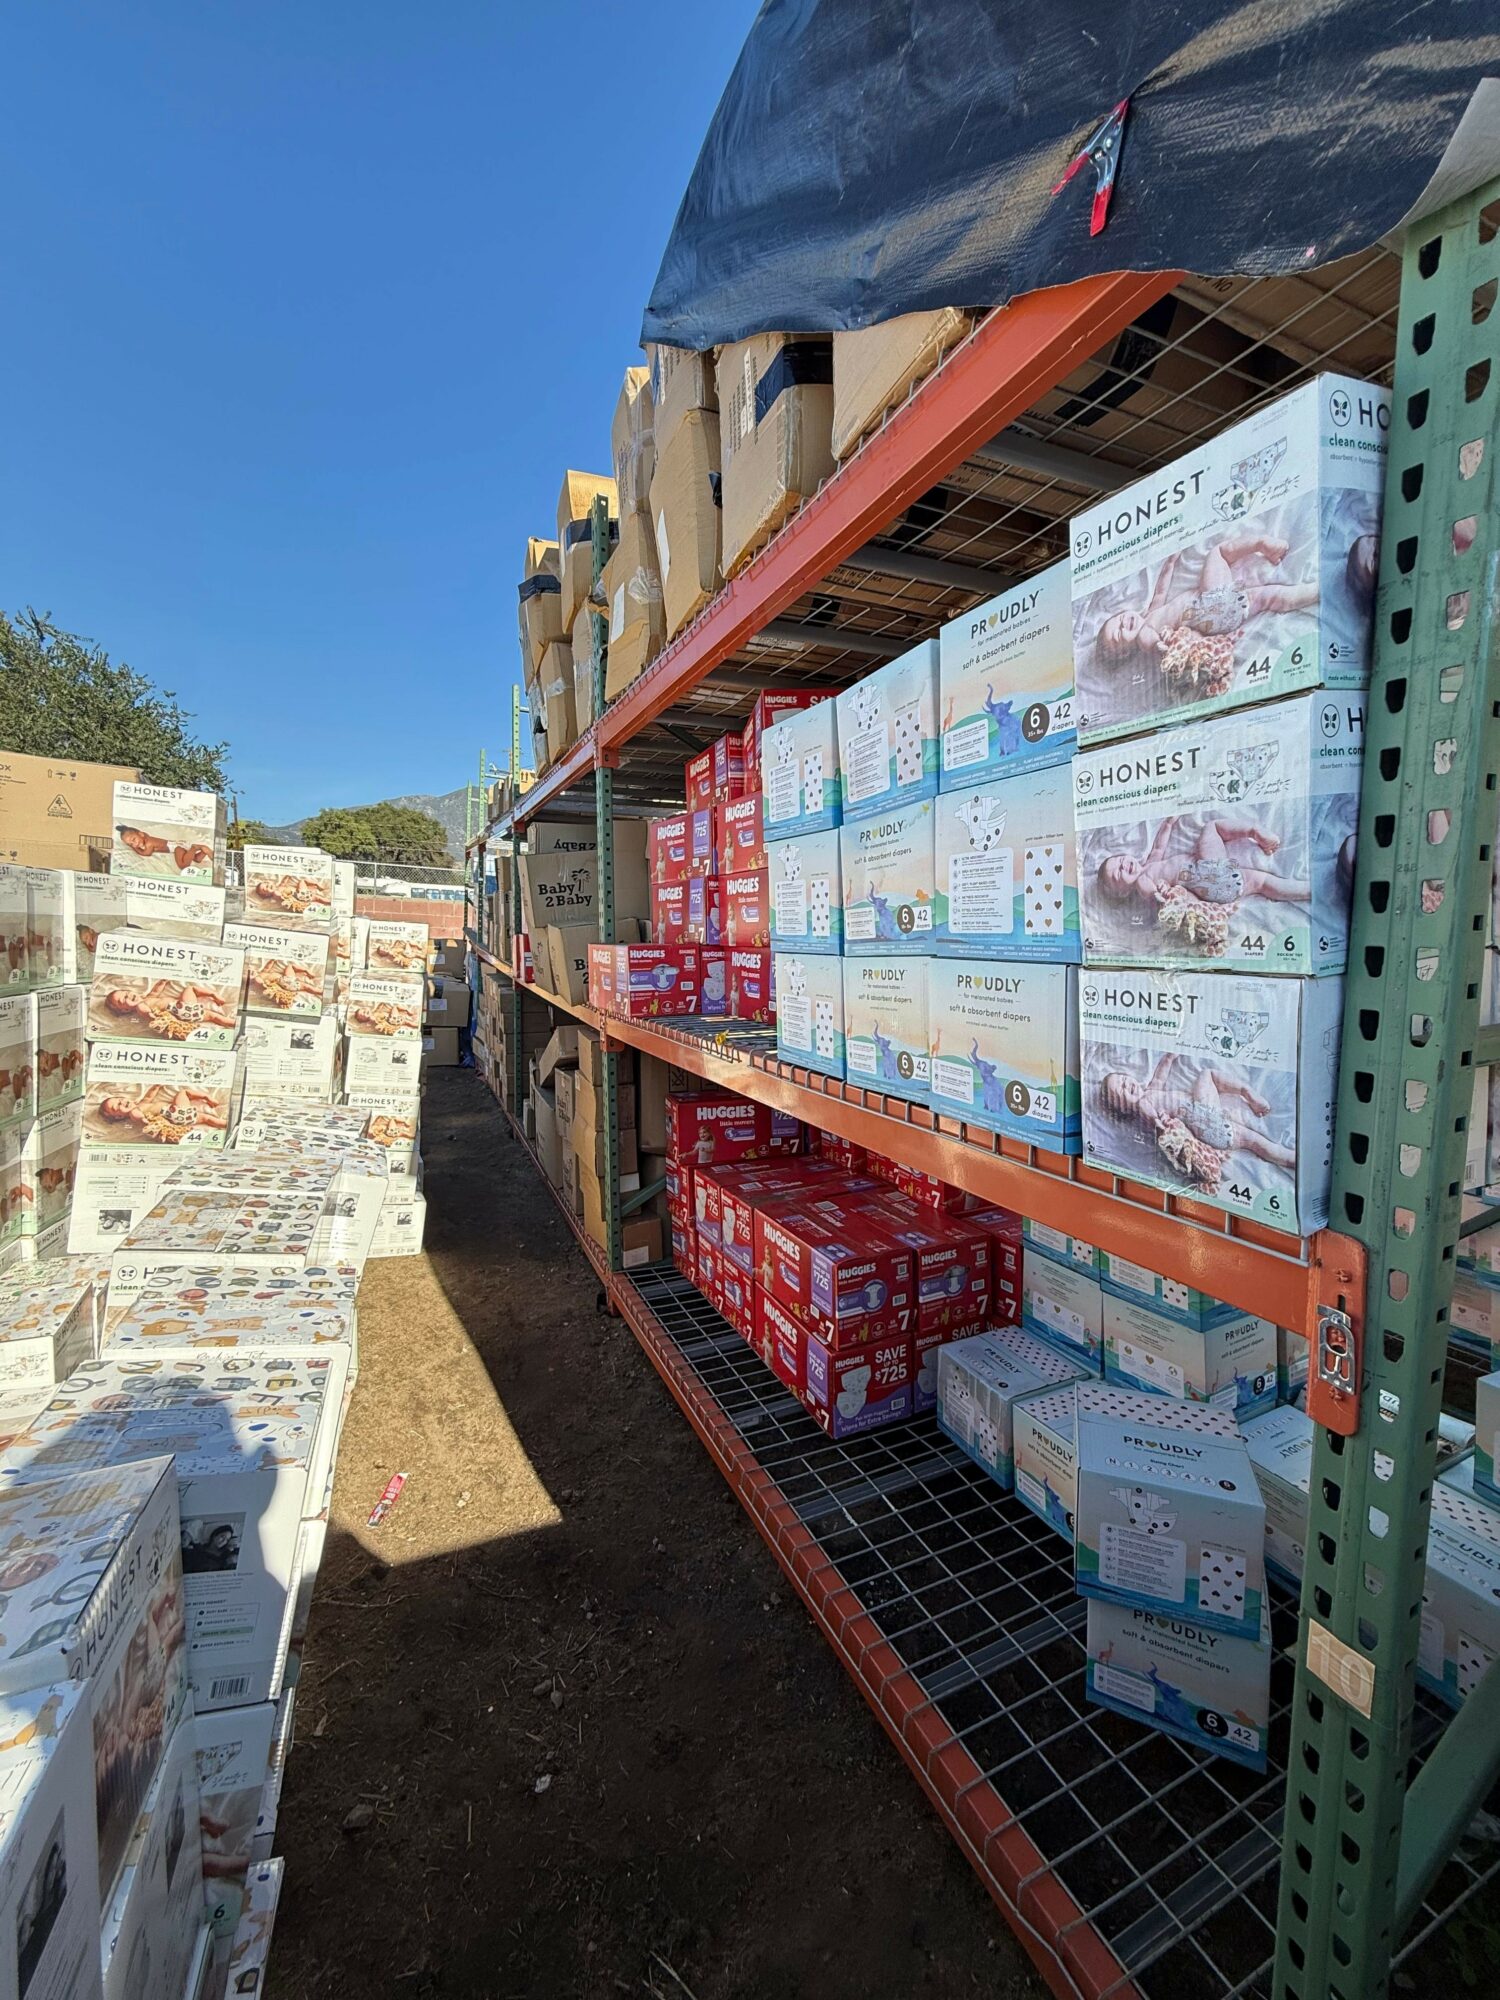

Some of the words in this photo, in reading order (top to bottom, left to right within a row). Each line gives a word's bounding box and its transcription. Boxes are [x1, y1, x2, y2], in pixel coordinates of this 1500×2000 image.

[1329, 432, 1355, 448] clean
[1098, 469, 1204, 546] HONEST
[1073, 559, 1095, 575] clean
[1097, 535, 1141, 563] conscious
[1143, 515, 1179, 540] diapers
[962, 657, 975, 671] soft
[975, 655, 981, 664] &
[982, 638, 1017, 661] absorbent
[1019, 624, 1050, 644] diapers
[1290, 647, 1303, 666] 6
[1246, 656, 1271, 678] 44
[764, 695, 797, 705] HUGGIES
[1030, 708, 1040, 728] 6
[1054, 702, 1071, 720] 42
[1051, 720, 1075, 732] diapers
[1320, 743, 1345, 757] clean
[1100, 747, 1200, 788] HONEST
[134, 786, 183, 800] HONEST
[723, 786, 729, 802] 7
[1076, 798, 1097, 808] clean
[1100, 789, 1141, 803] conscious
[1143, 782, 1177, 796] diapers
[725, 800, 756, 823] HUGGIES
[657, 822, 686, 840] HUGGIES
[262, 853, 305, 864] HONEST
[867, 852, 892, 863] absorbent
[892, 847, 912, 858] diapers
[703, 859, 710, 876] 7
[83, 876, 109, 885] HONEST
[138, 881, 190, 895] HONEST
[537, 883, 575, 895] Baby
[726, 877, 760, 896] HUGGIES
[658, 886, 683, 902] HUGGIES
[902, 908, 910, 923] 6
[917, 910, 928, 921] 42
[240, 933, 289, 946] HONEST
[698, 927, 705, 944] 7
[1240, 935, 1265, 951] 44
[1284, 935, 1295, 951] 6
[123, 943, 196, 961] HONEST
[630, 950, 666, 959] HUGGIES
[731, 952, 762, 969] HUGGIES
[362, 983, 399, 992] HONEST
[41, 991, 65, 1003] HONEST
[685, 995, 697, 1013] 7
[893, 995, 913, 1004] diapers
[1104, 989, 1198, 1014] HONEST
[949, 1004, 961, 1013] soft
[961, 1005, 967, 1013] &
[967, 1005, 1001, 1019] absorbent
[1002, 1010, 1031, 1023] diapers
[1083, 1010, 1101, 1019] clean
[1104, 1013, 1143, 1024] conscious
[1144, 1015, 1177, 1030] diapers
[194, 1030, 209, 1039] 44
[218, 1032, 225, 1040] 6
[117, 1051, 189, 1065] HONEST
[901, 1054, 908, 1069] 6
[916, 1061, 927, 1073] 42
[360, 1097, 397, 1105] HONEST
[1012, 1085, 1022, 1103] 6
[1034, 1095, 1049, 1111] 42
[44, 1107, 68, 1124] HONEST
[697, 1105, 755, 1120] HUGGIES
[1031, 1109, 1053, 1121] diapers
[187, 1133, 201, 1141] 44
[789, 1138, 799, 1154] 7
[845, 1153, 852, 1168] 7
[706, 1183, 718, 1200] SAVE
[931, 1190, 941, 1209] 7
[1229, 1183, 1252, 1201] 44
[1269, 1195, 1280, 1210] 6
[682, 1207, 688, 1223] 7
[736, 1204, 750, 1222] SAVE
[42, 1223, 64, 1244] HONEST
[763, 1221, 800, 1262] HUGGIES
[921, 1249, 957, 1266] HUGGIES
[690, 1267, 695, 1283] 7
[838, 1262, 877, 1280] HUGGIES
[115, 1283, 138, 1291] clean
[717, 1295, 724, 1312] 7
[976, 1294, 989, 1315] 7
[1005, 1297, 1017, 1319] 7
[62, 1302, 82, 1339] HONEST
[763, 1297, 798, 1345] HUGGIES
[898, 1309, 910, 1331] 7
[746, 1323, 753, 1342] 7
[825, 1320, 835, 1343] 7
[916, 1333, 943, 1347] HUGGIES
[951, 1322, 981, 1341] SAVE
[835, 1355, 865, 1369] HUGGIES
[875, 1344, 907, 1364] SAVE
[875, 1363, 907, 1385] $725
[1256, 1378, 1262, 1388] 6
[820, 1408, 830, 1431] 7
[86, 1545, 143, 1667] HONEST
[1122, 1629, 1138, 1639] soft
[1140, 1634, 1147, 1642] &
[1149, 1637, 1193, 1660] absorbent
[1195, 1655, 1230, 1674] diapers
[1206, 1713, 1218, 1728] 6
[1233, 1727, 1252, 1742] 42
[213, 1903, 225, 1919] 6
